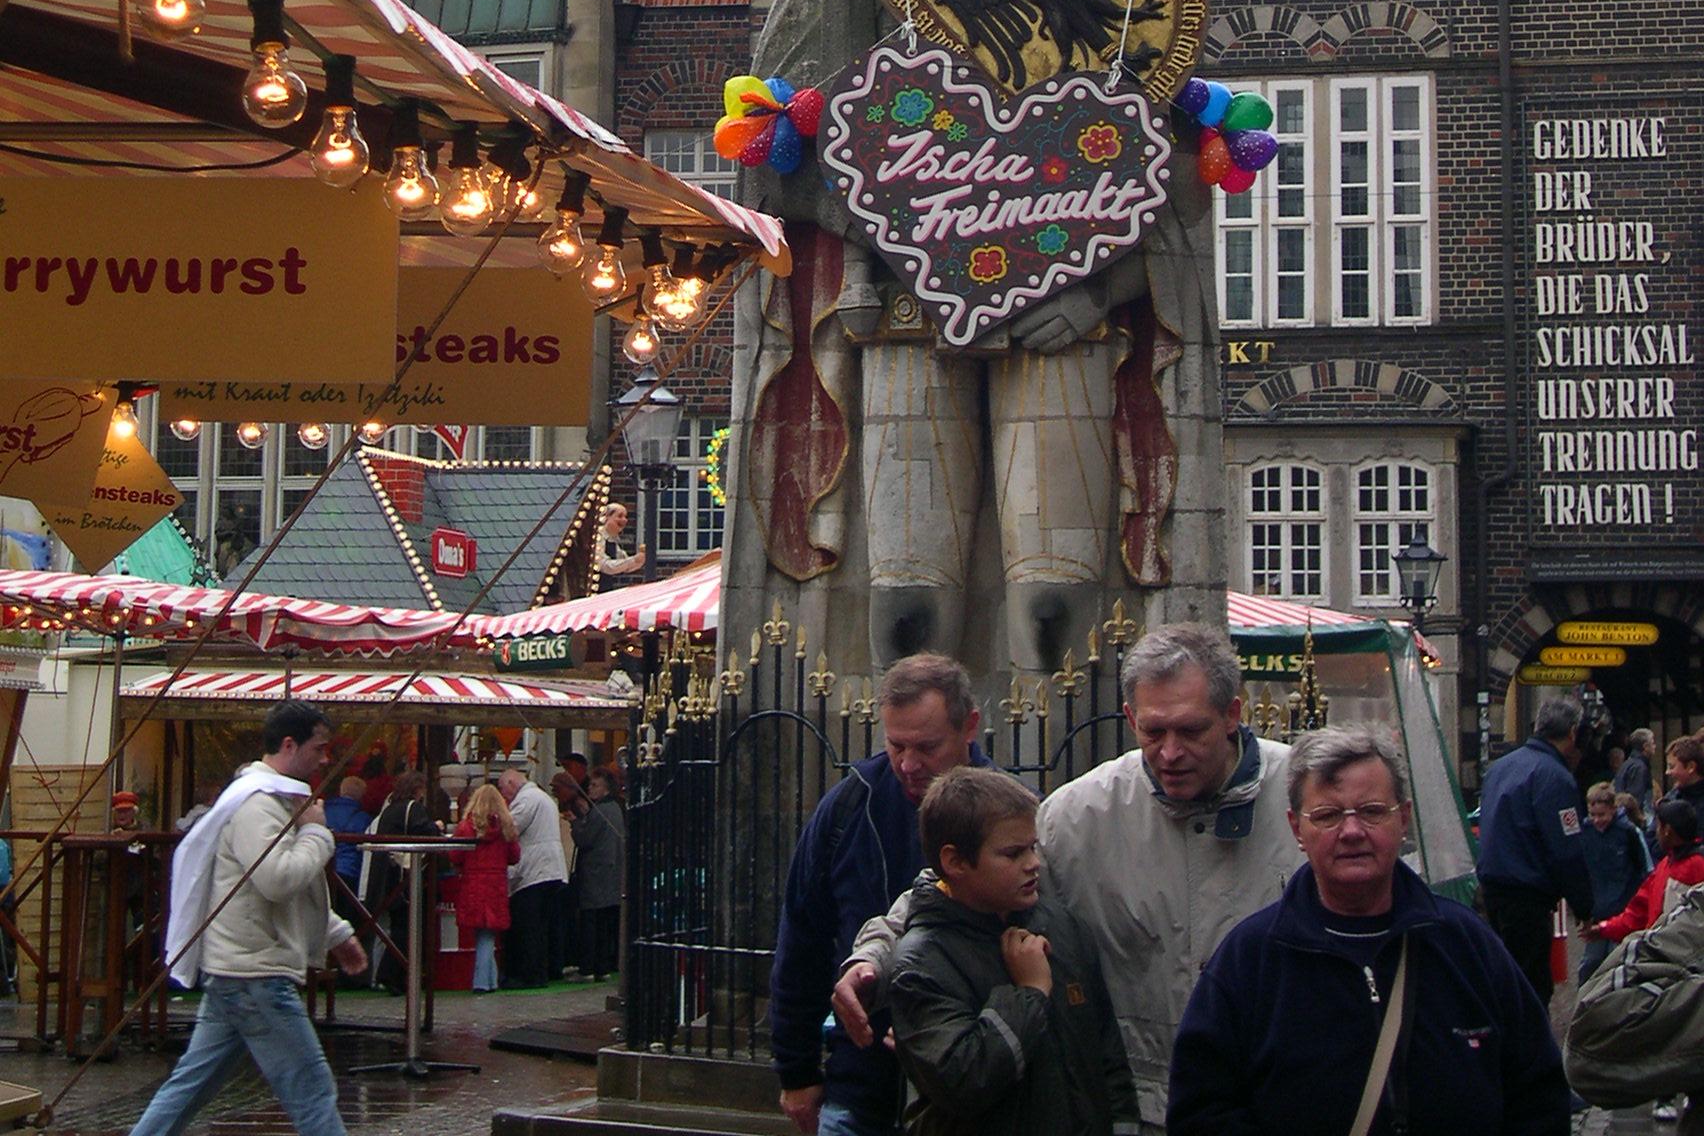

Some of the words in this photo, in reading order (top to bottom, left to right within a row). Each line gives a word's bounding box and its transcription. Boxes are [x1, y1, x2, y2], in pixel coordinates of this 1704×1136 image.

[876, 129, 1034, 183] Ischa
[1534, 117, 1667, 161] GEDENKE
[910, 172, 1146, 243] Freimaakt
[1534, 170, 1592, 212] DER
[3, 246, 308, 306] rrywurst
[1536, 275, 1584, 316] DIE
[1594, 273, 1649, 314] DAS
[1537, 324, 1695, 368] SCHICKSAL
[225, 381, 292, 403] Kraut
[1538, 377, 1676, 420] UNSERER
[1538, 429, 1699, 472] TRENNUNG
